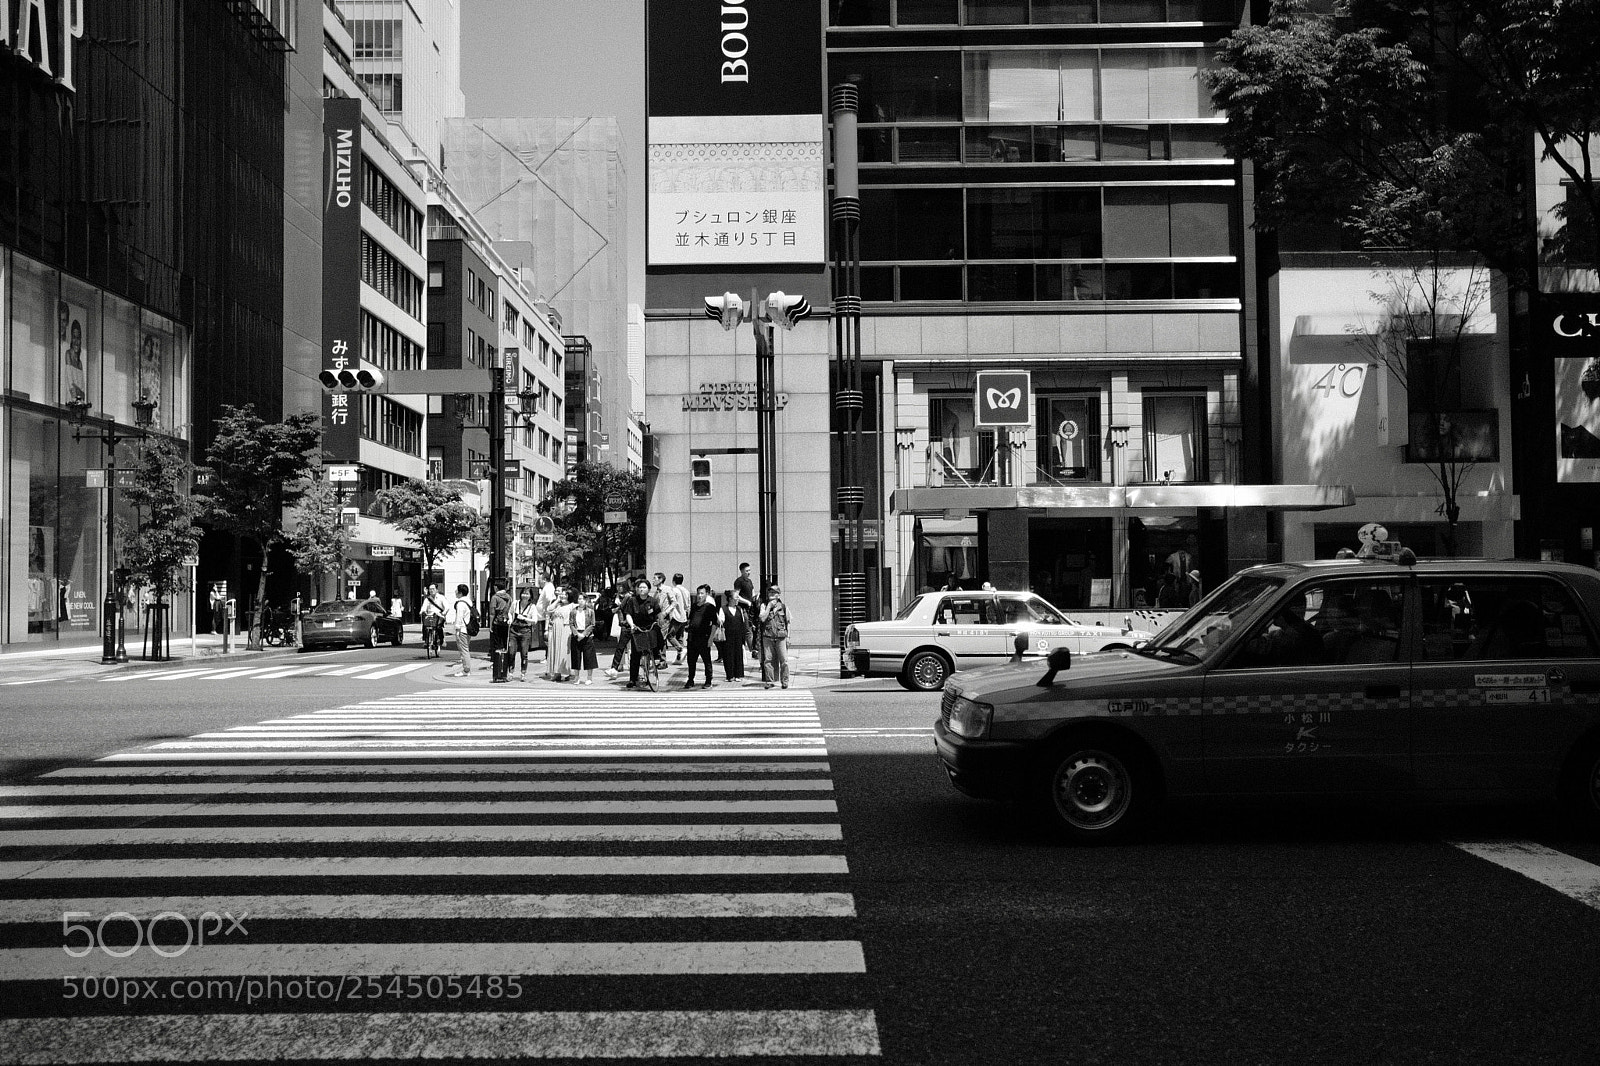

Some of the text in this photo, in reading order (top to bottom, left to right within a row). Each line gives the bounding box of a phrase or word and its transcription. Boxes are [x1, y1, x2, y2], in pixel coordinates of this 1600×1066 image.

[0, 0, 85, 93] AP
[721, 0, 749, 84] BOU
[337, 129, 353, 208] MIZUHO
[675, 209, 797, 225] ブシュロン銀座
[675, 231, 797, 247] 並木通り5丁目
[332, 339, 349, 425] みず銀行
[682, 393, 789, 412] MEN'S SHP
[1528, 689, 1548, 702] 41
[1284, 742, 1332, 753] タクシー
